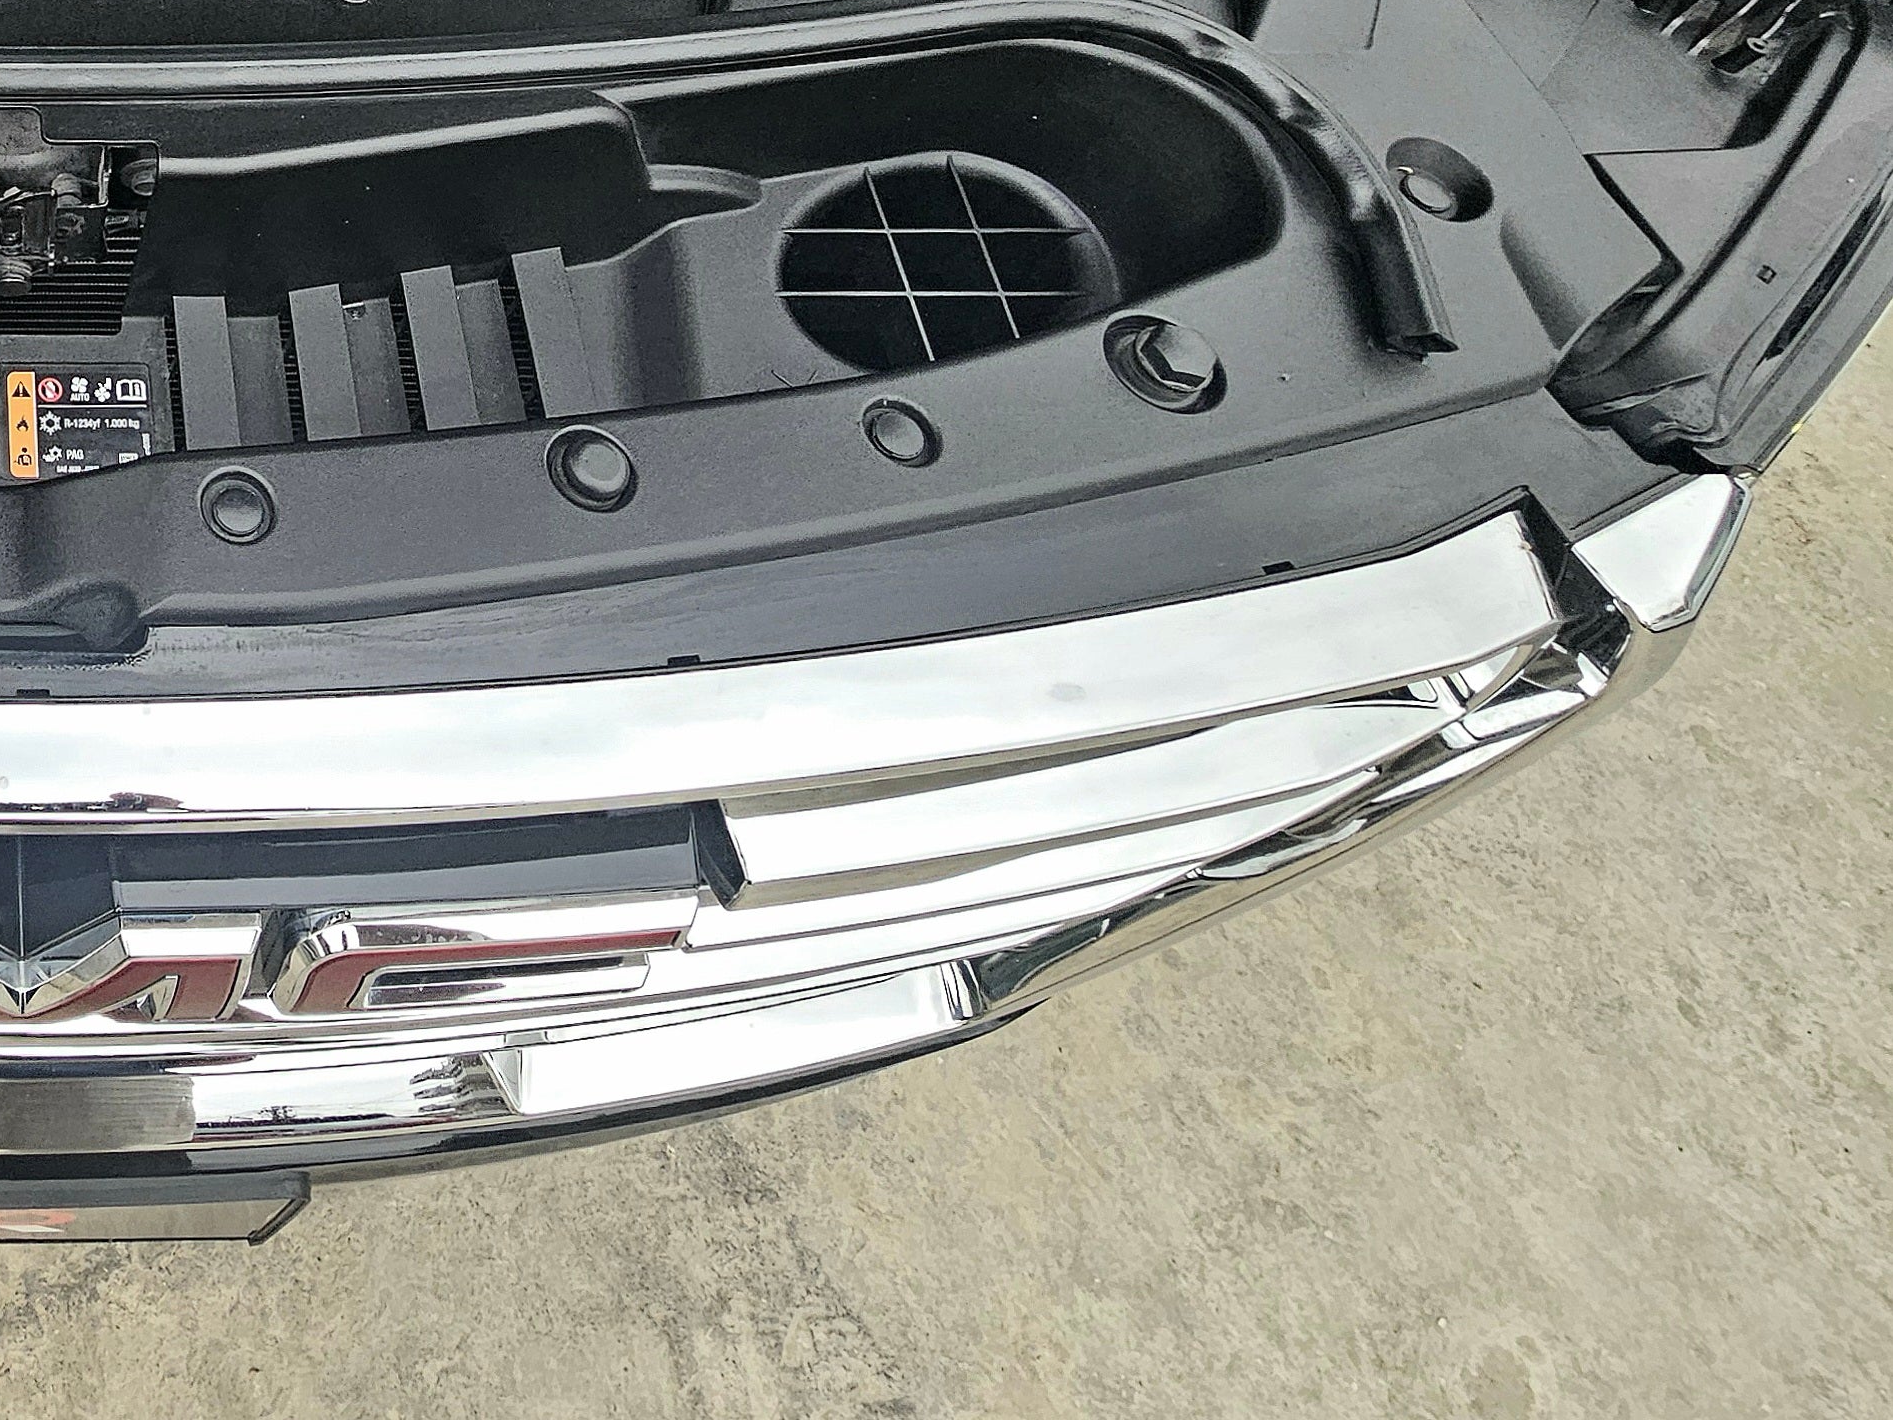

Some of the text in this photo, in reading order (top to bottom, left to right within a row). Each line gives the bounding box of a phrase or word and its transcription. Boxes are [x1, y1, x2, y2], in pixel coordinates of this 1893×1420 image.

[70, 393, 90, 402] AUTO
[64, 418, 140, 430] R-1234yf 1.000 kg
[66, 449, 84, 460] PAG
